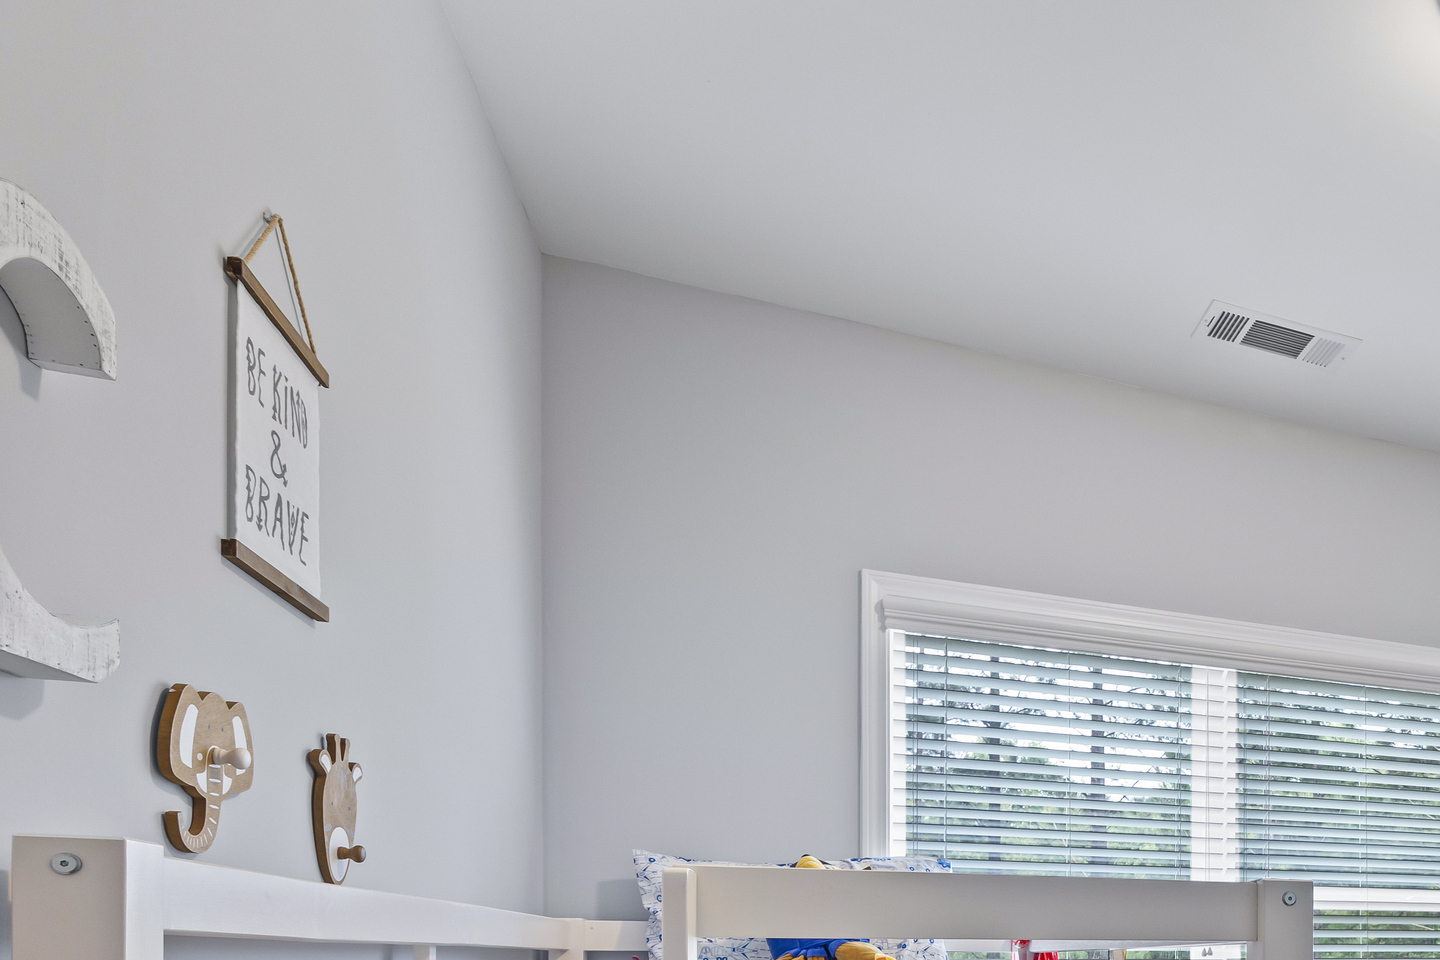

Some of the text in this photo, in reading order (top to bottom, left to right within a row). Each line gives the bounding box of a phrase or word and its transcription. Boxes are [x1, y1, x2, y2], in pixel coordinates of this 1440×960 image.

[245, 336, 267, 409] BE
[270, 430, 288, 488] &
[245, 464, 310, 567] BRAVE
